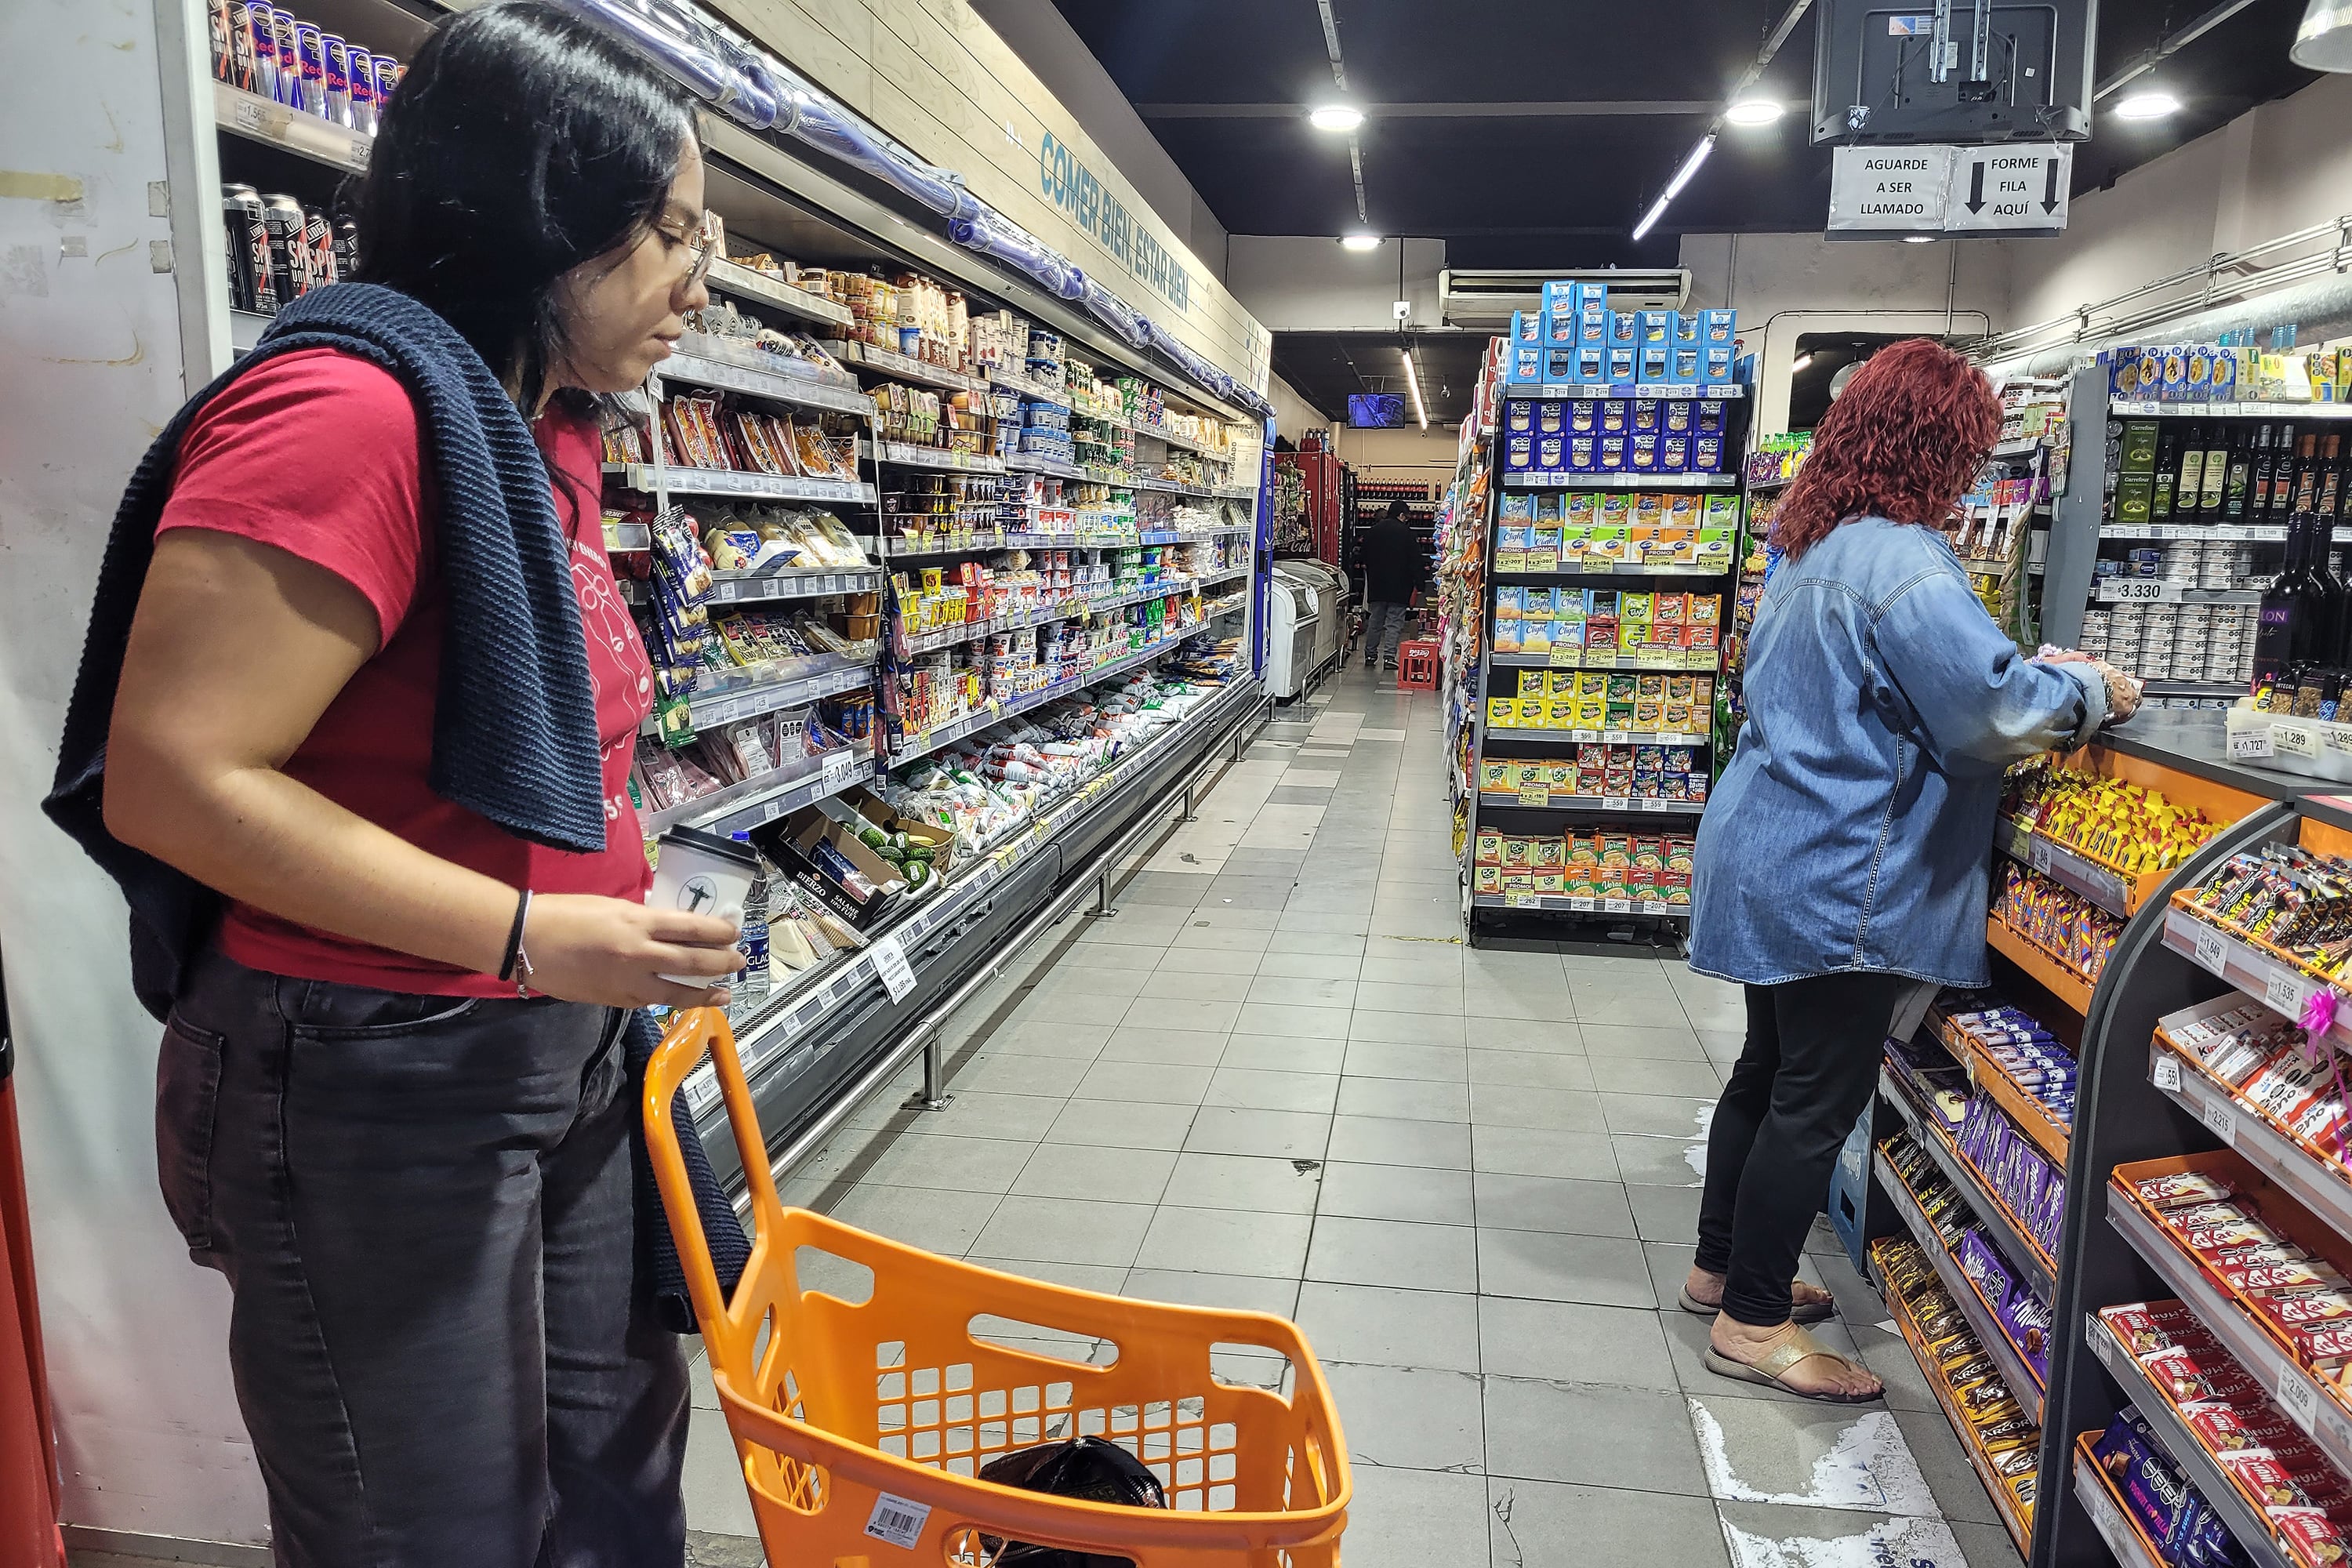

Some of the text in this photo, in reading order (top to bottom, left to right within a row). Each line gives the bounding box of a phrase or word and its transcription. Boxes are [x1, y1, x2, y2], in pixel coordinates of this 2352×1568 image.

[1864, 158, 1928, 171] AGUARDE
[1991, 157, 2039, 169] FORME
[1876, 181, 1913, 194] A SER
[1999, 180, 2027, 193] FILA
[1860, 203, 1925, 216] LLAMADO
[1993, 200, 2030, 216] AQUÍ
[1040, 132, 1099, 236] COMER
[1135, 228, 1169, 298] ESTAR
[1167, 253, 1189, 314] BIEN
[1505, 502, 1529, 514] Clight
[1503, 532, 1525, 543] Clight
[1498, 591, 1520, 602] Clight
[2118, 584, 2161, 598] $3.330
[1529, 598, 1551, 609] Clight
[1561, 597, 1583, 608] Clight
[1497, 623, 1519, 635] Clight
[1526, 624, 1548, 636] Clight
[1558, 626, 1580, 637] Clight
[2275, 682, 2296, 691] INTEGRA
[2281, 731, 2306, 746] $1.289
[796, 870, 826, 897] BIERZO
[830, 898, 858, 922] TIPO FUET
[833, 894, 860, 916] SALAME
[2204, 938, 2220, 959] $1.649
[2274, 982, 2295, 1002] $1.535
[2198, 1044, 2221, 1057] Kin
[1962, 1253, 1988, 1283] Milka
[2013, 1298, 2052, 1331] Milka
[1942, 1337, 1979, 1358] ARCO
[1980, 1419, 2031, 1440] ARCOR
